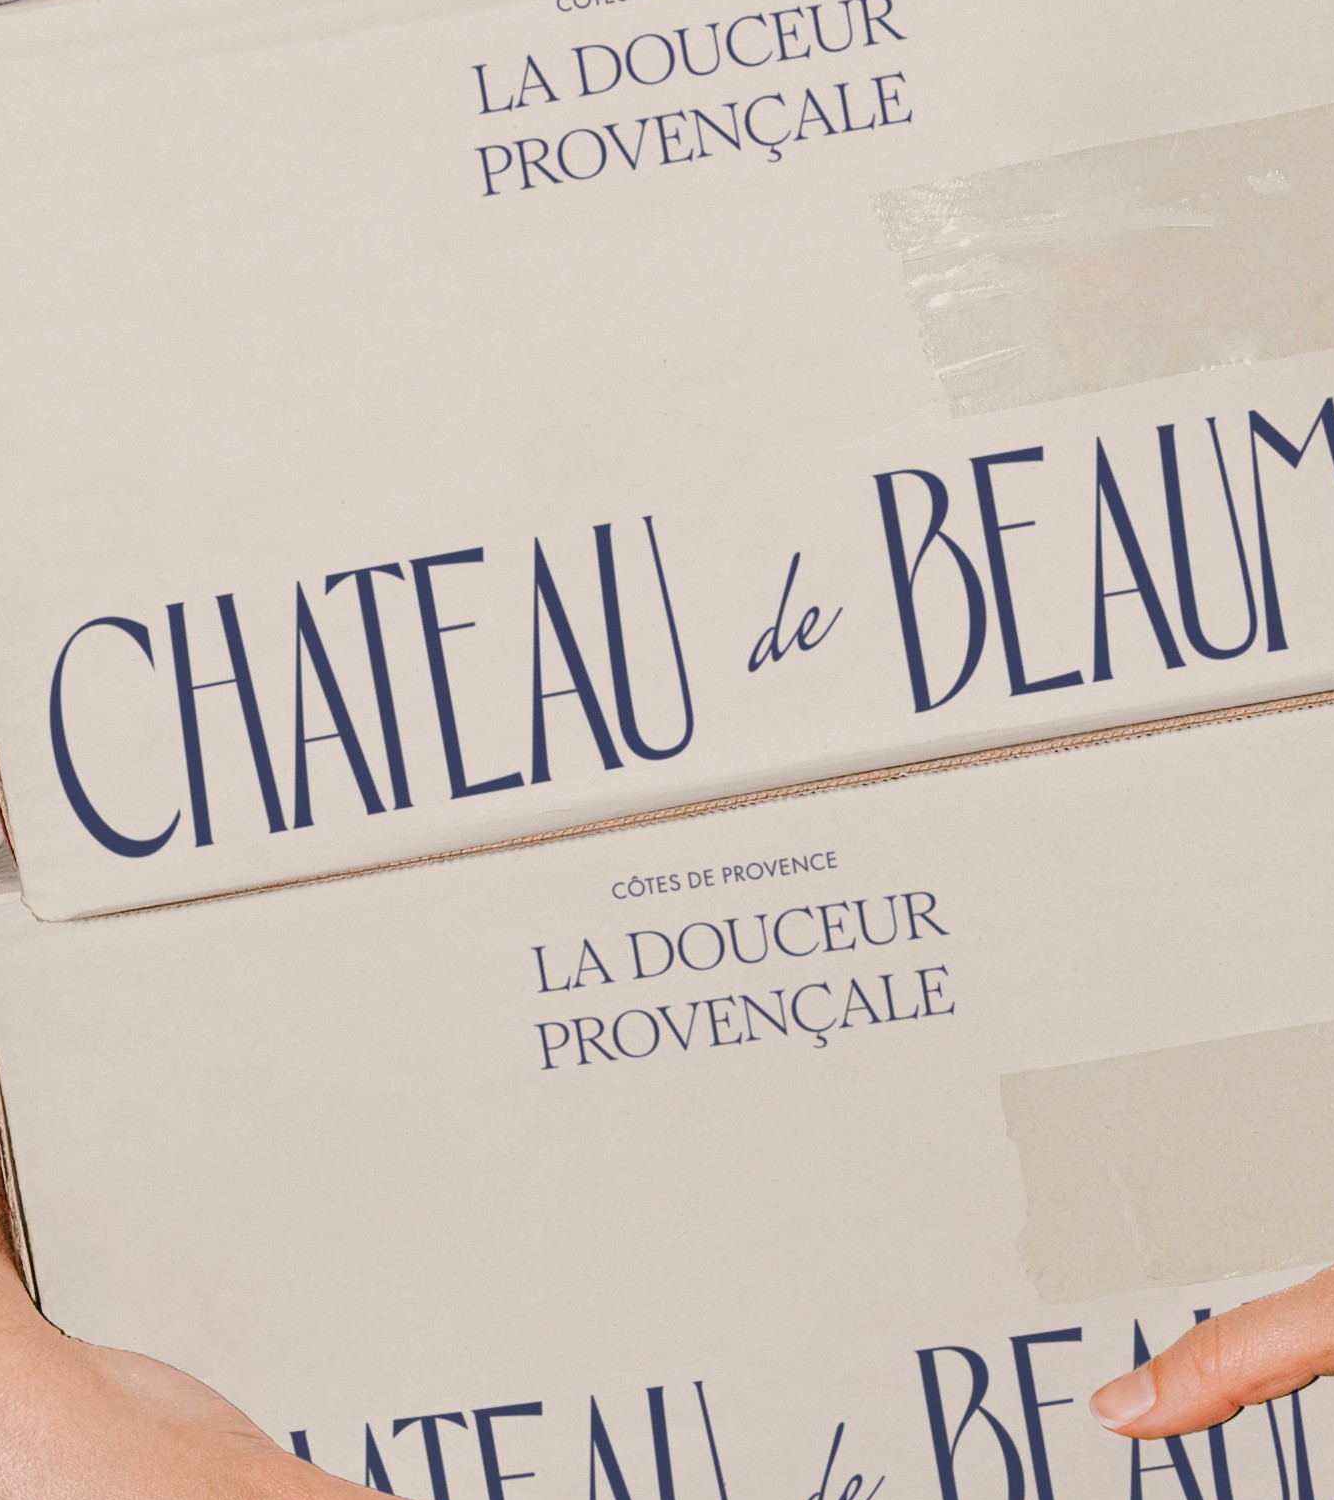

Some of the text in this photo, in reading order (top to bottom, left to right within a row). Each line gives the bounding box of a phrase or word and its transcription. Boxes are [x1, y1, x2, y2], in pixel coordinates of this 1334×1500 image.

[471, 55, 559, 114] LA
[476, 72, 912, 196] PROVENÇALE
[49, 515, 694, 858] CHATEAU
[747, 552, 843, 673] de
[612, 852, 837, 899] CÔTES DE PROVENCE
[531, 892, 949, 993] LA DOUCEUR
[536, 965, 955, 1070] PROVENÇALE
